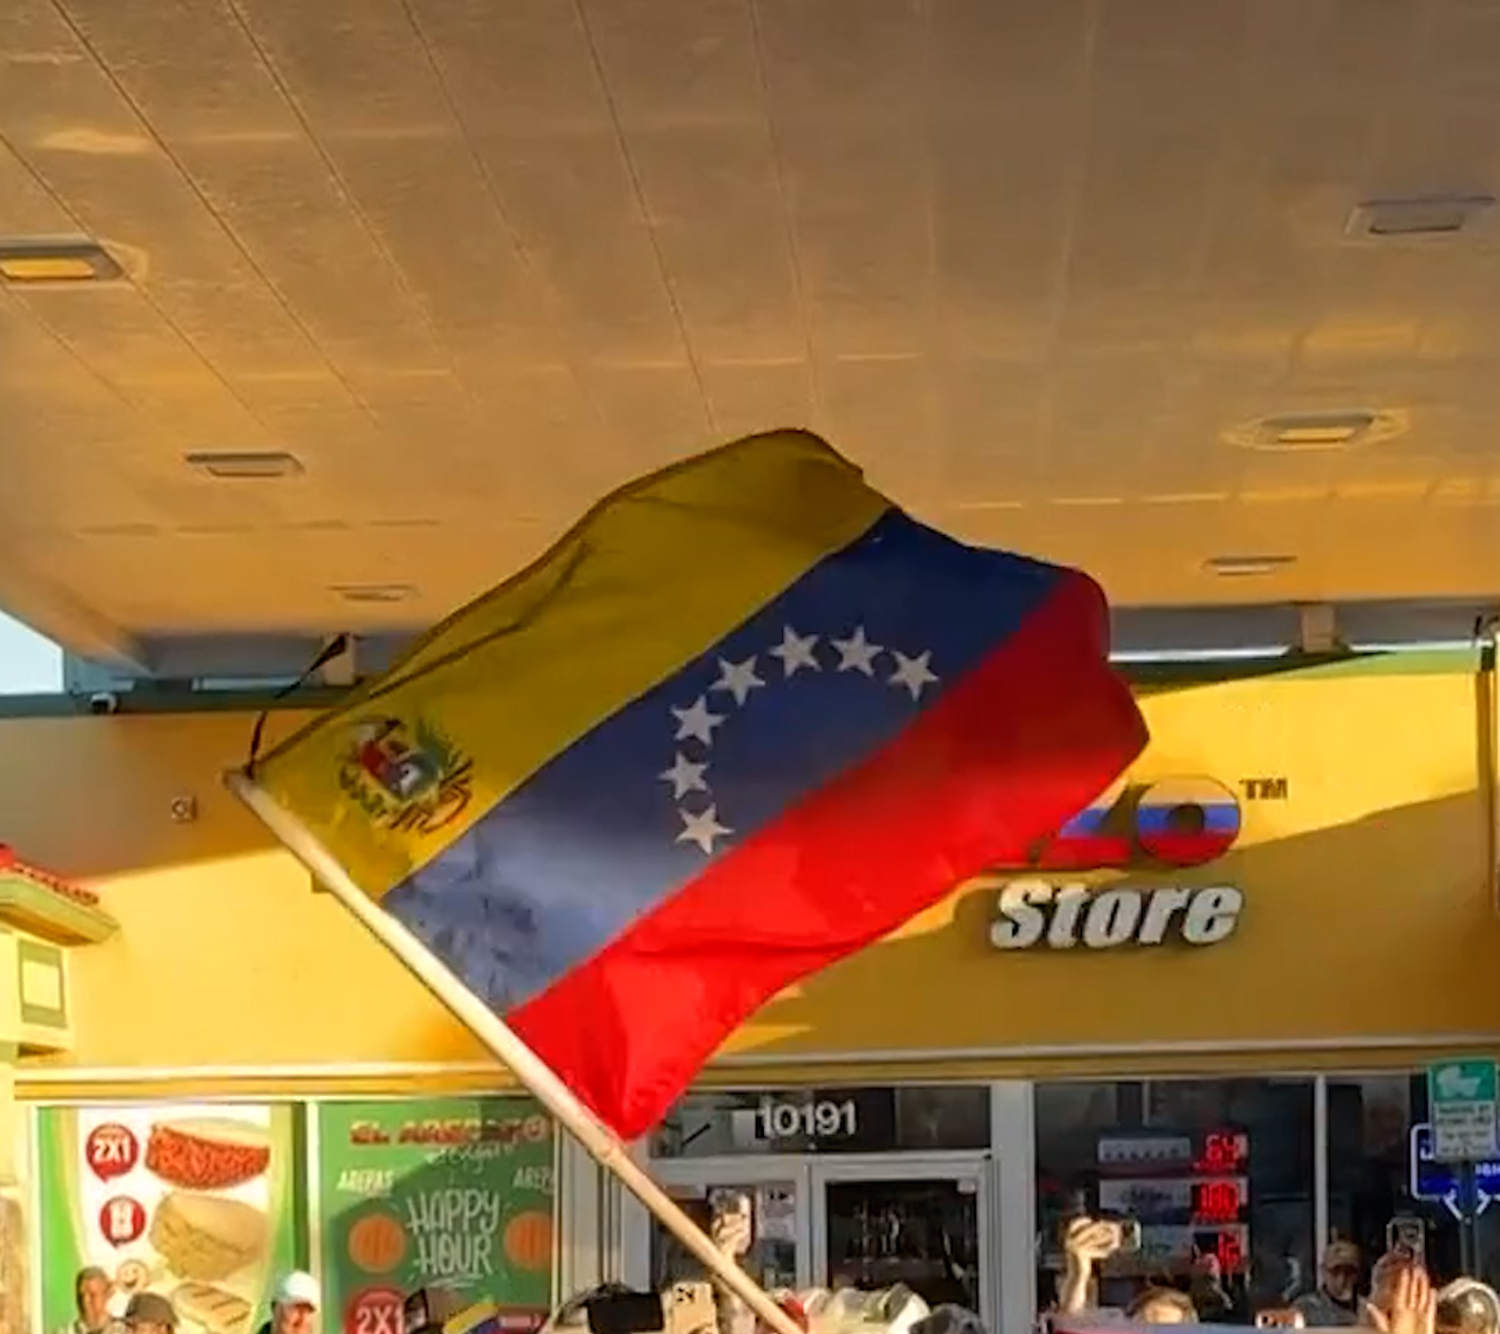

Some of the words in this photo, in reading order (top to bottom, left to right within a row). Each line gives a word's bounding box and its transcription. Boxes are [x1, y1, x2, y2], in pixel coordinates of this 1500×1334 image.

[990, 880, 1244, 949] Store
[753, 1099, 857, 1136] 10191
[93, 1138, 131, 1163] 2X1
[406, 1189, 500, 1235] HAPPY
[413, 1233, 494, 1276] HOUR
